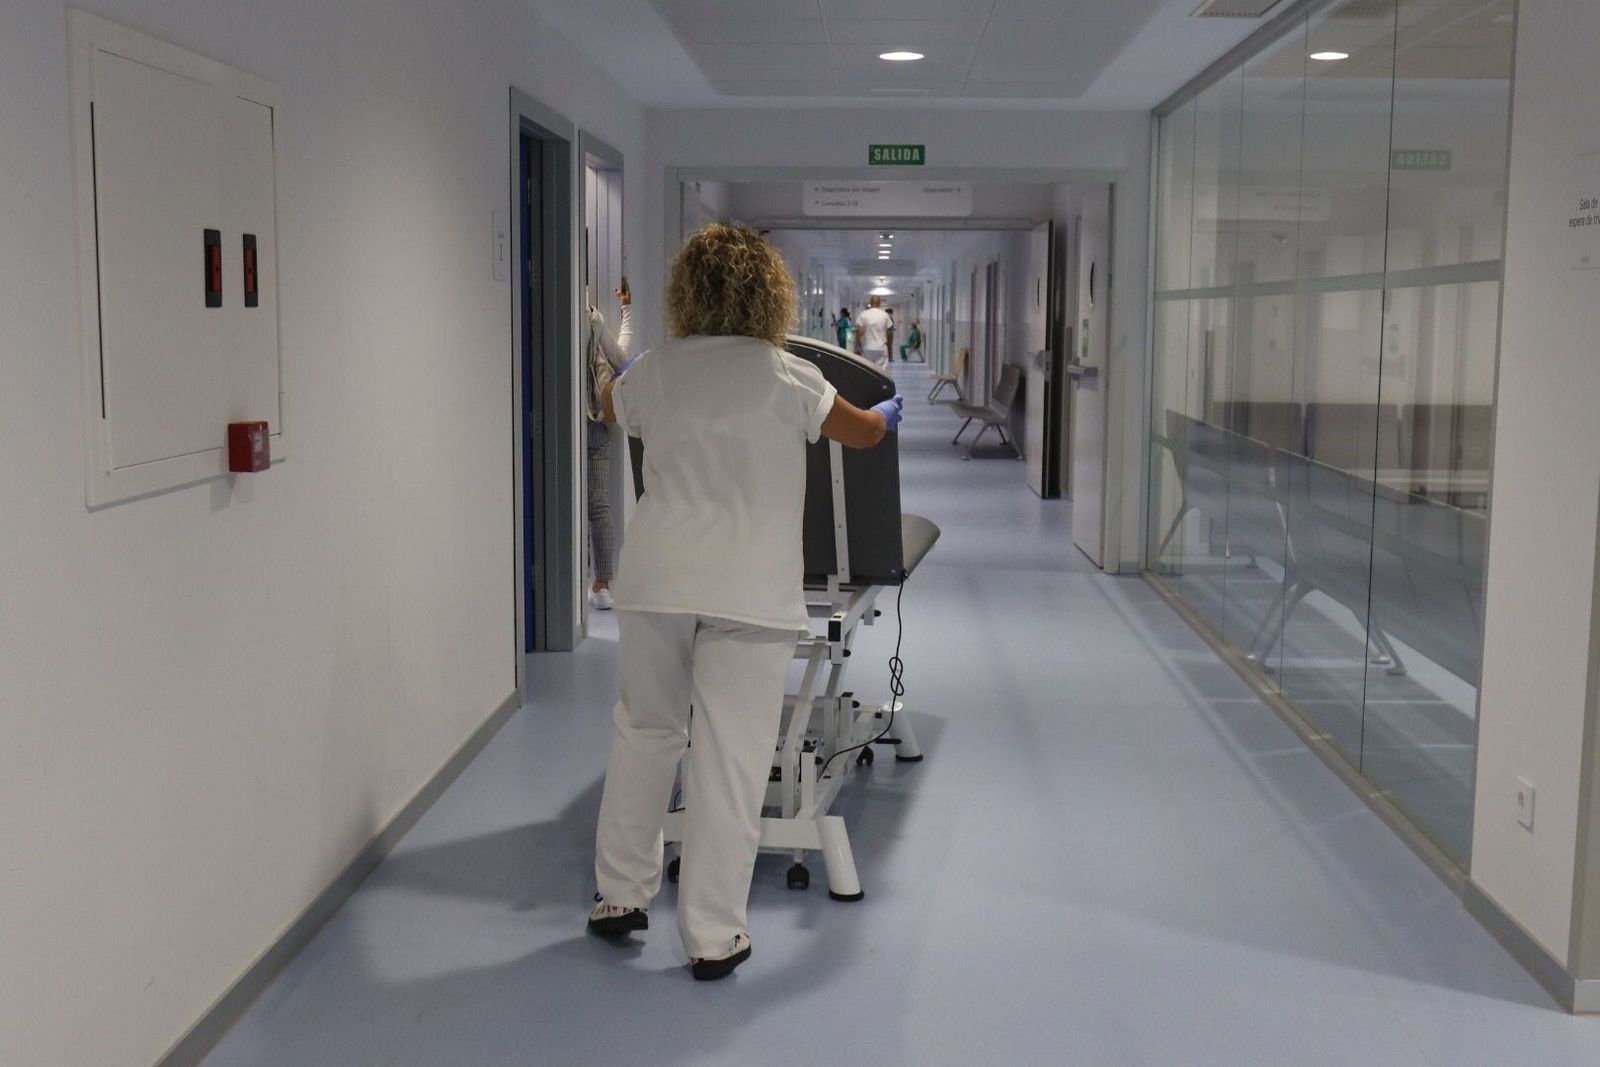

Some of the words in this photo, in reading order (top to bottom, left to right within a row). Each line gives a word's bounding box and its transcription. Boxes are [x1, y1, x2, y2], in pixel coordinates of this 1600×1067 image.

[874, 148, 920, 161] SALIDA
[1579, 198, 1590, 210] Sala
[1591, 197, 1598, 209] de
[1586, 215, 1593, 225] de
